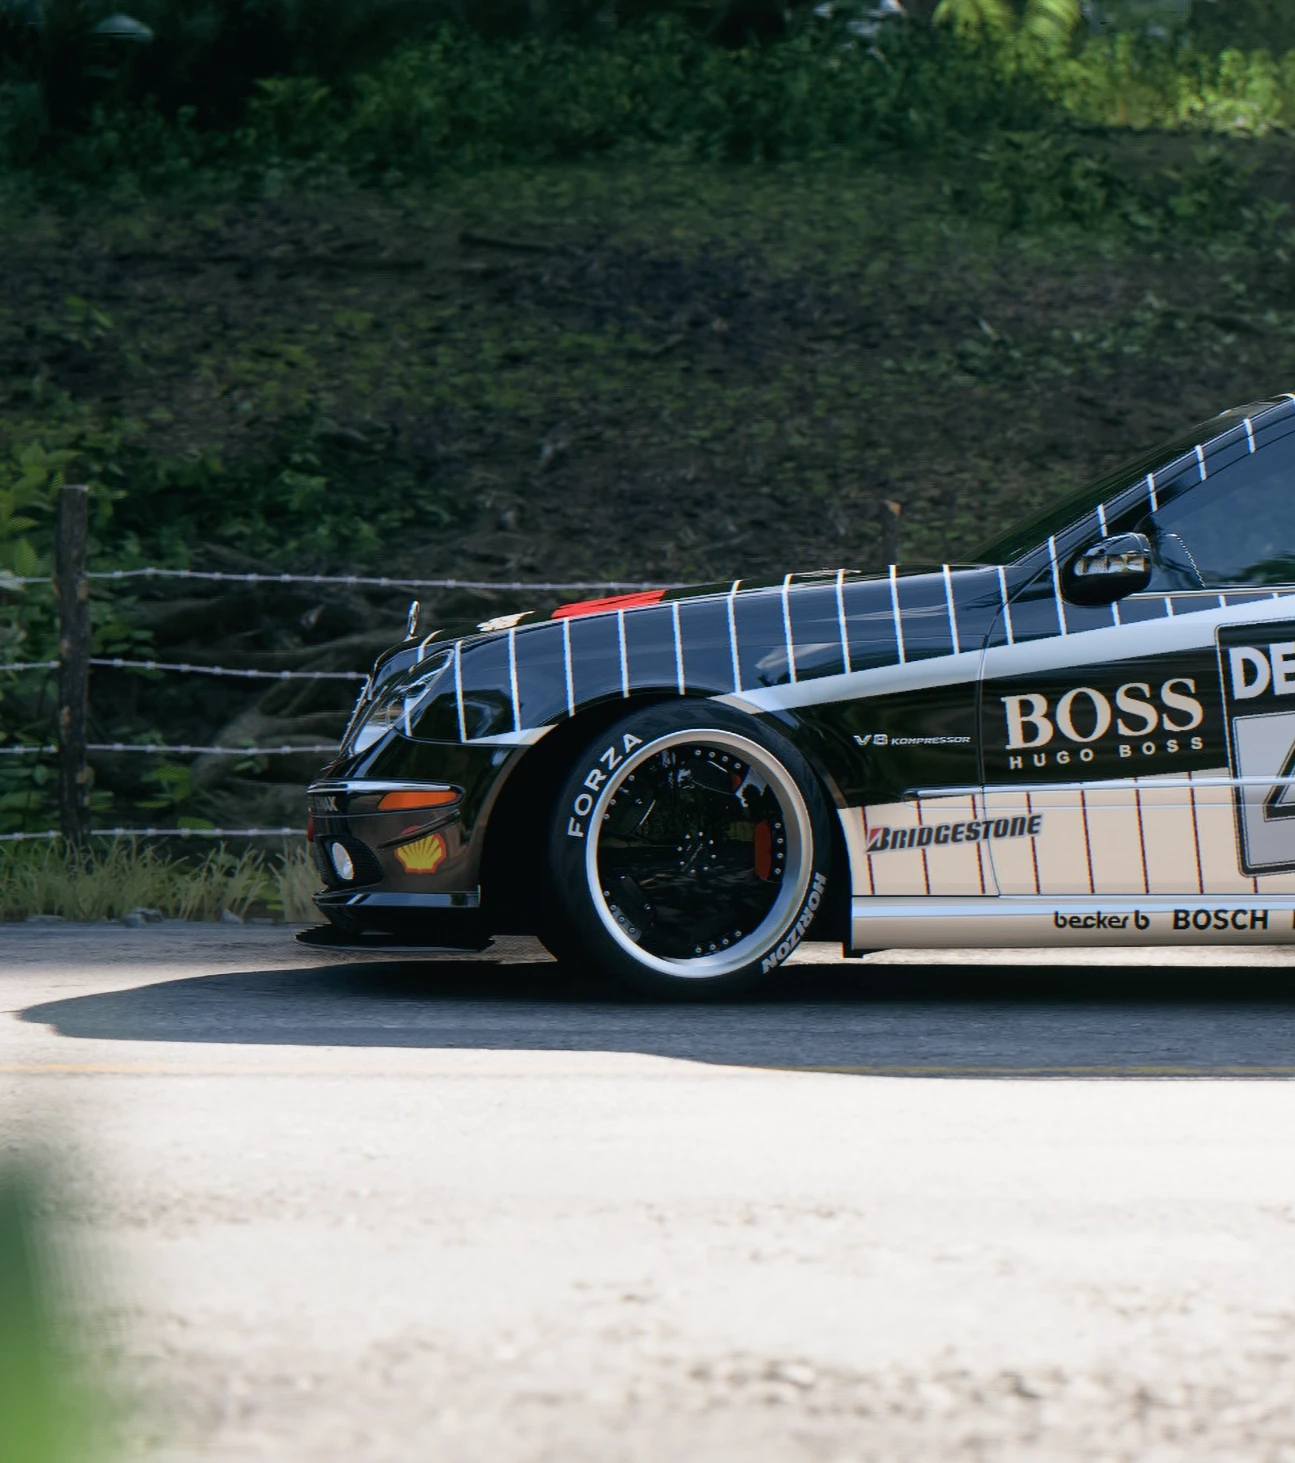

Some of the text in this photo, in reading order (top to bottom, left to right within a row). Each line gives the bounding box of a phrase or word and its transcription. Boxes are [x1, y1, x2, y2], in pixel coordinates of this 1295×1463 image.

[1000, 678, 1204, 750] BOSS
[853, 733, 972, 746] V8 KOMPRESSOR
[1009, 736, 1204, 770] HUGO BOSS
[567, 733, 644, 838] FORZA
[866, 814, 1044, 853] BRIDGESTONE
[761, 872, 828, 974] HORIZON
[1053, 910, 1130, 929] becker
[1172, 908, 1269, 930] BOSCH
